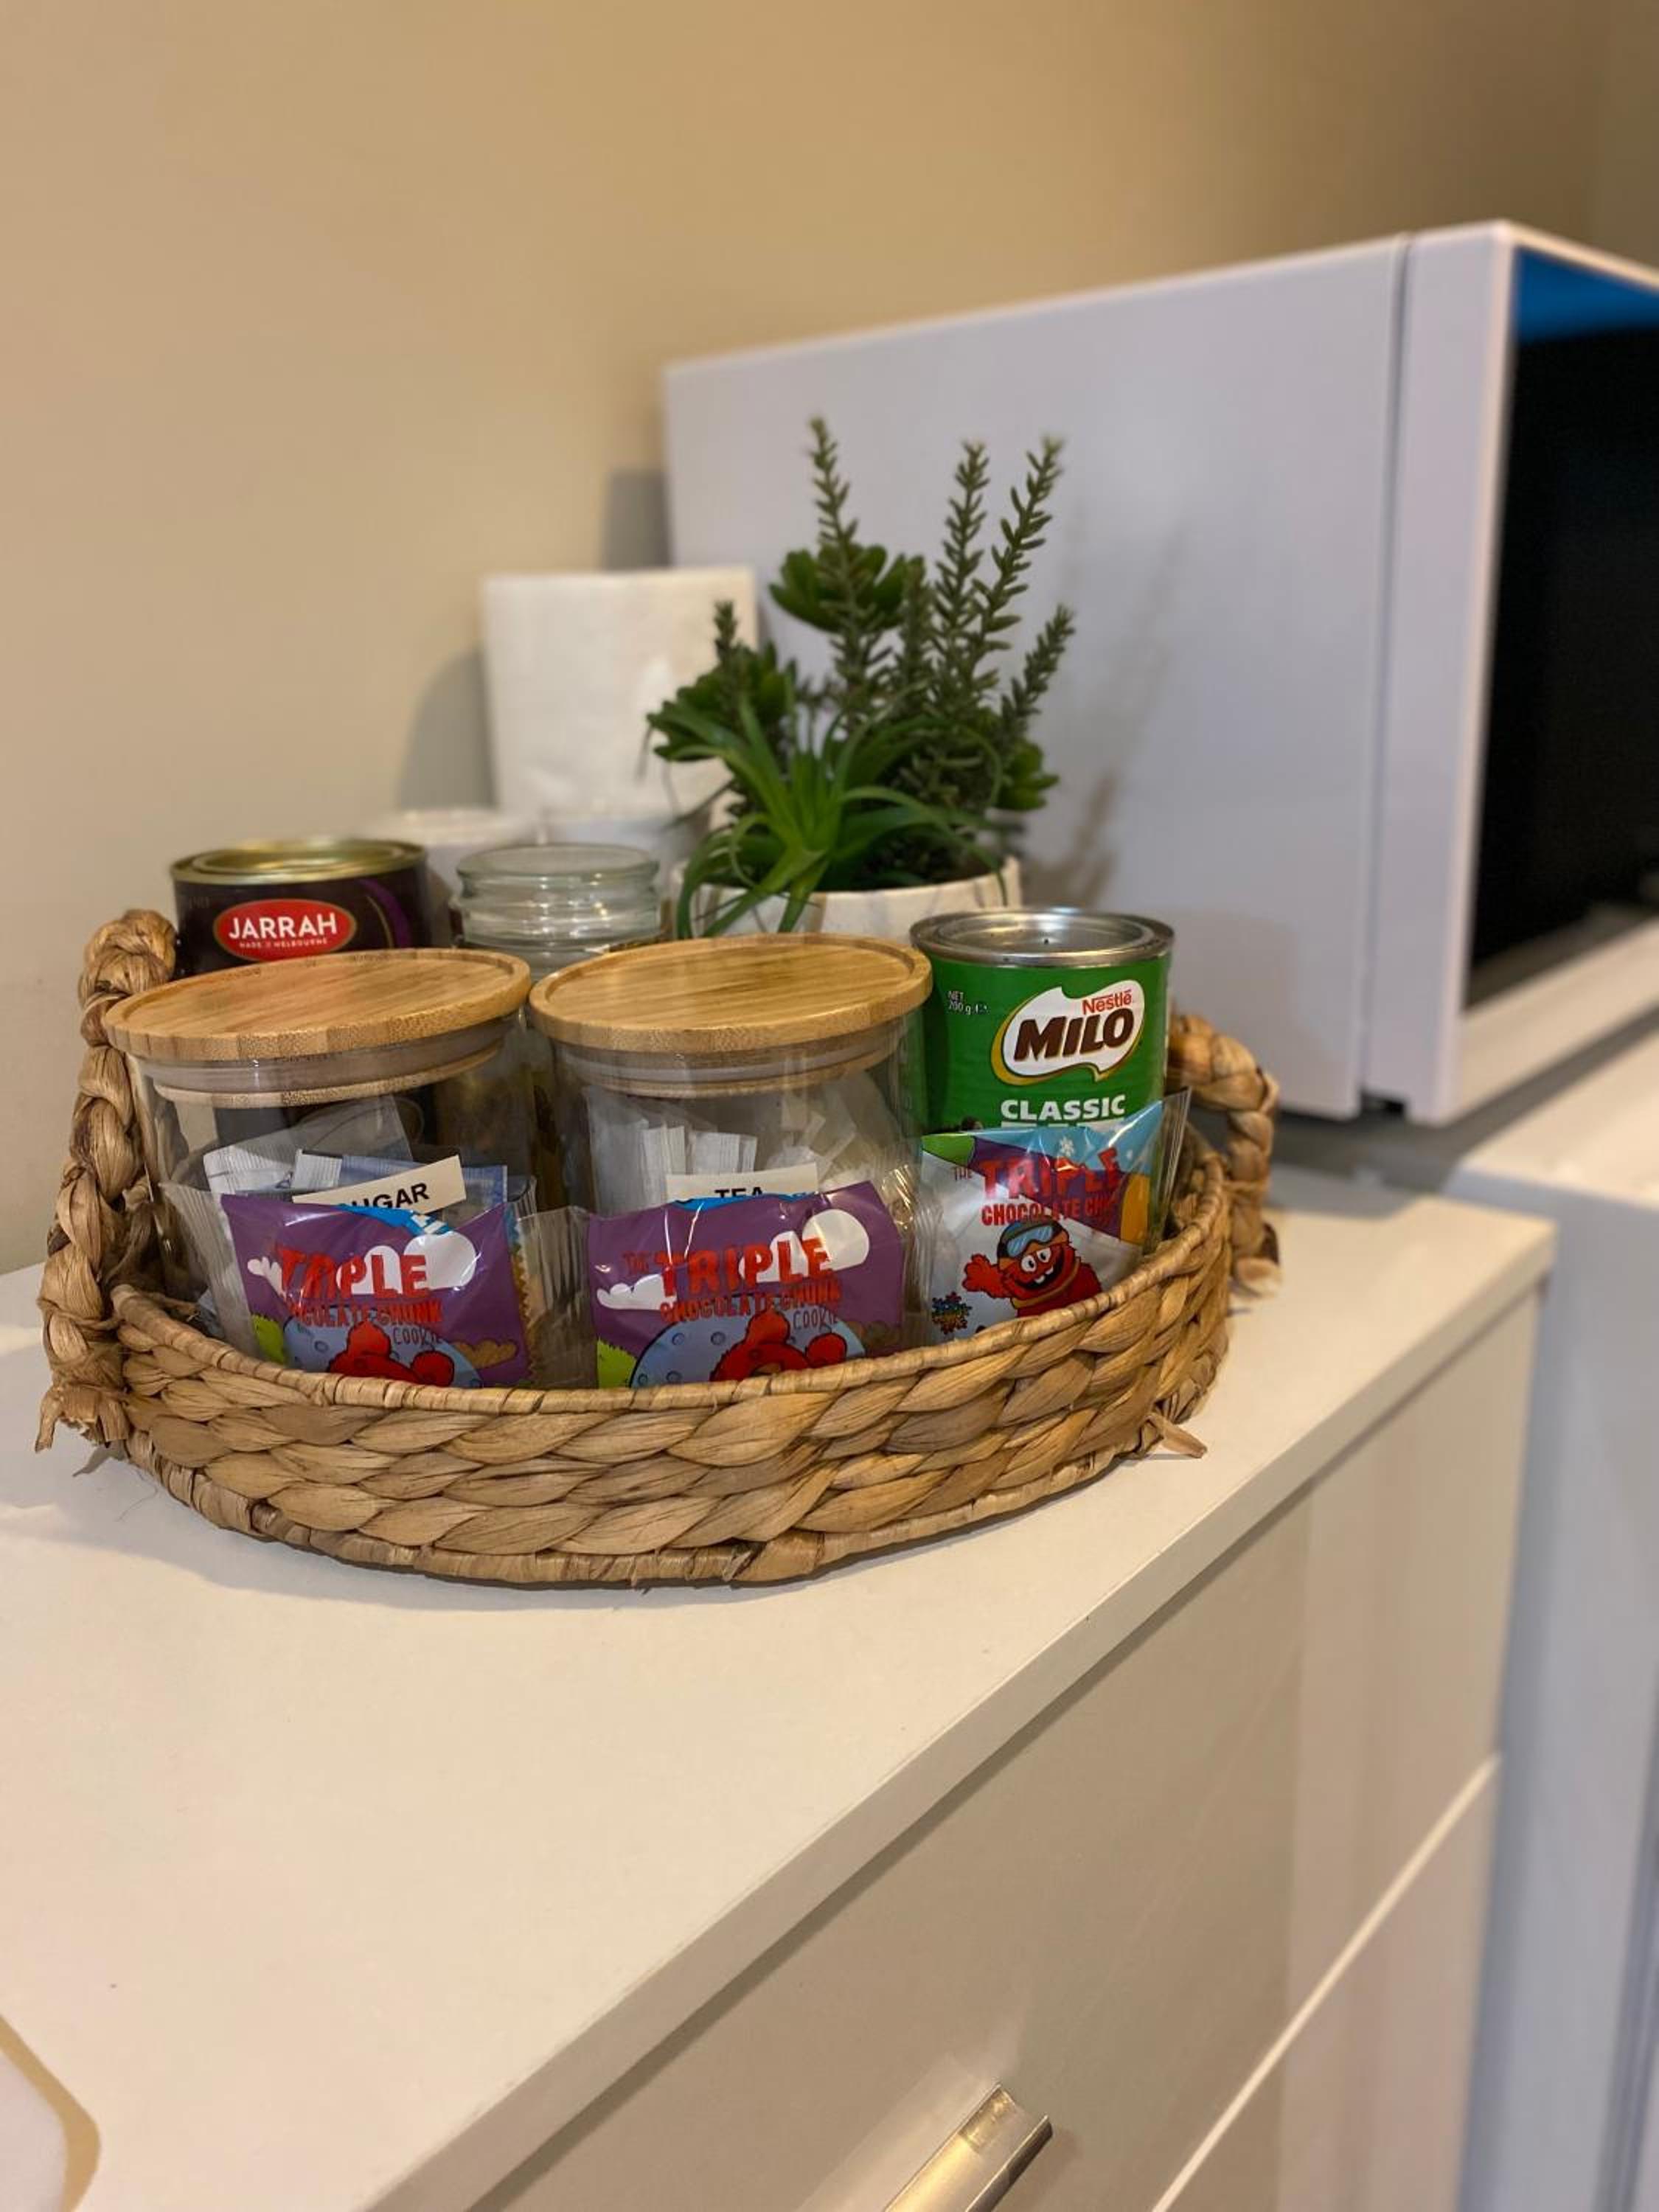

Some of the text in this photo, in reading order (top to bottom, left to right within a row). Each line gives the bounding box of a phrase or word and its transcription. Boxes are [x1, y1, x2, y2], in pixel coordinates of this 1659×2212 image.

[229, 912, 337, 939] JARRAH
[1013, 1007, 1135, 1061] MILO
[1001, 1094, 1126, 1121] CLASSIC
[351, 1182, 429, 1209] GAR
[655, 1237, 834, 1298] TRIPLE
